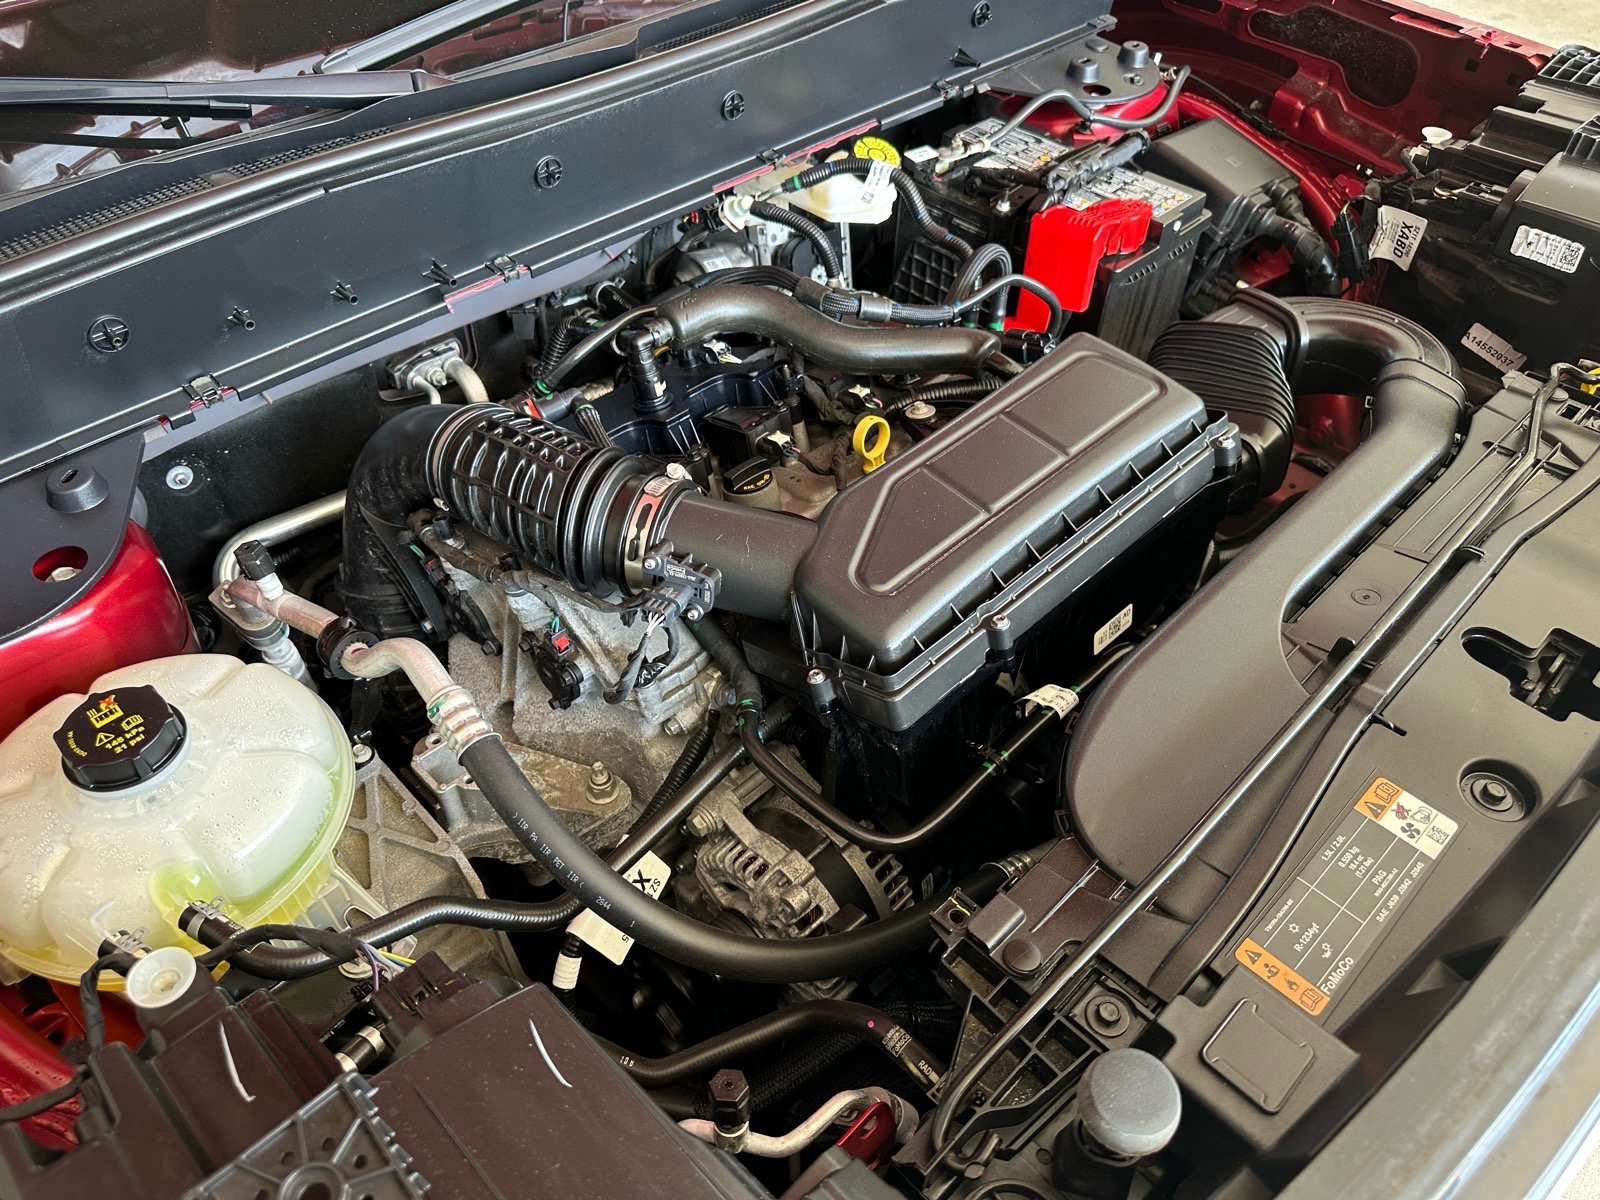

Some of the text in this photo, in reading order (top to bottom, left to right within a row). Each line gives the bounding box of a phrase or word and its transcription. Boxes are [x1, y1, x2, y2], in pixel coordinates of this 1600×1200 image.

[1393, 221, 1414, 258] XABD
[105, 726, 145, 750] 145 kPa
[553, 857, 565, 869] PET
[1371, 868, 1386, 885] PAG
[1375, 908, 1389, 922] SAE
[1293, 921, 1320, 952] R-1234yf
[1320, 954, 1355, 995] FoMoCo
[917, 1060, 933, 1076] RAD
